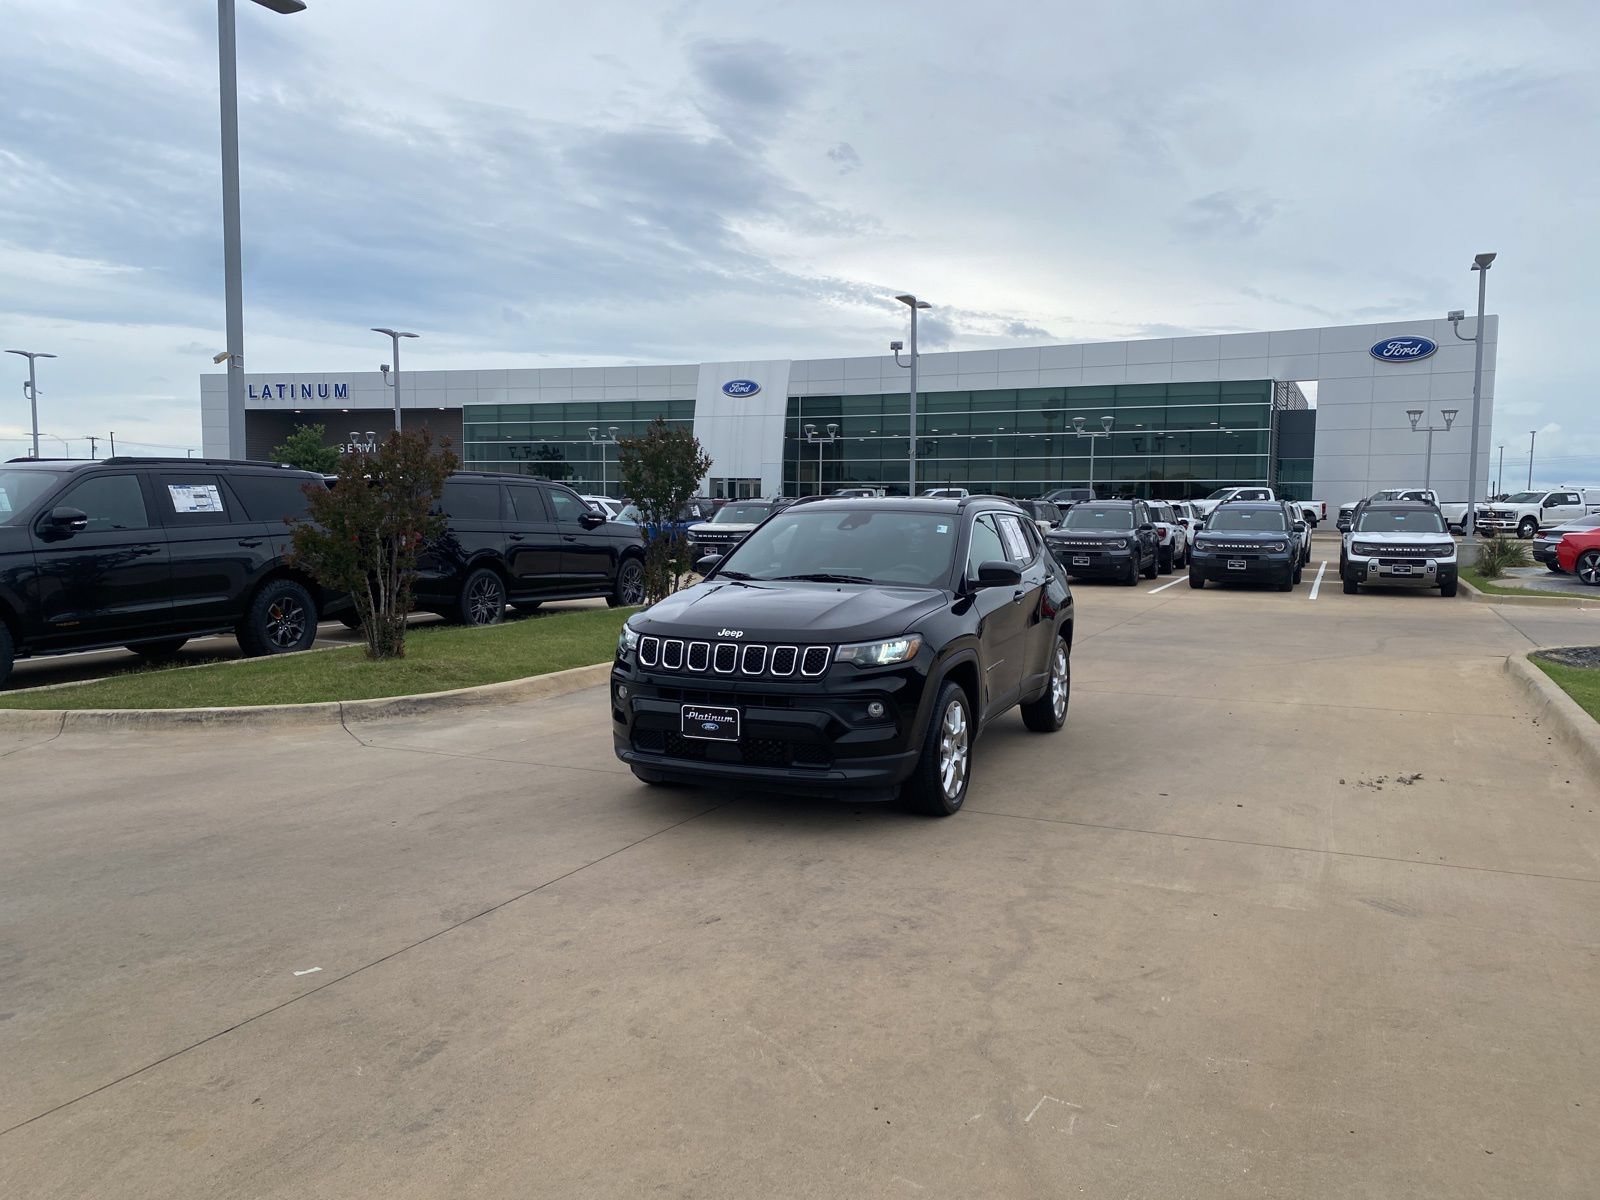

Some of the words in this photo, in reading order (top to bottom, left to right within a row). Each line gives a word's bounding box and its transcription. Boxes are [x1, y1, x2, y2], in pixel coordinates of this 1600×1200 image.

[1383, 341, 1422, 356] Ford
[248, 383, 349, 399] LATINUM
[729, 382, 751, 393] Ford
[339, 443, 385, 453] SERVI
[717, 628, 744, 639] Jeep
[685, 711, 736, 723] Platinum
